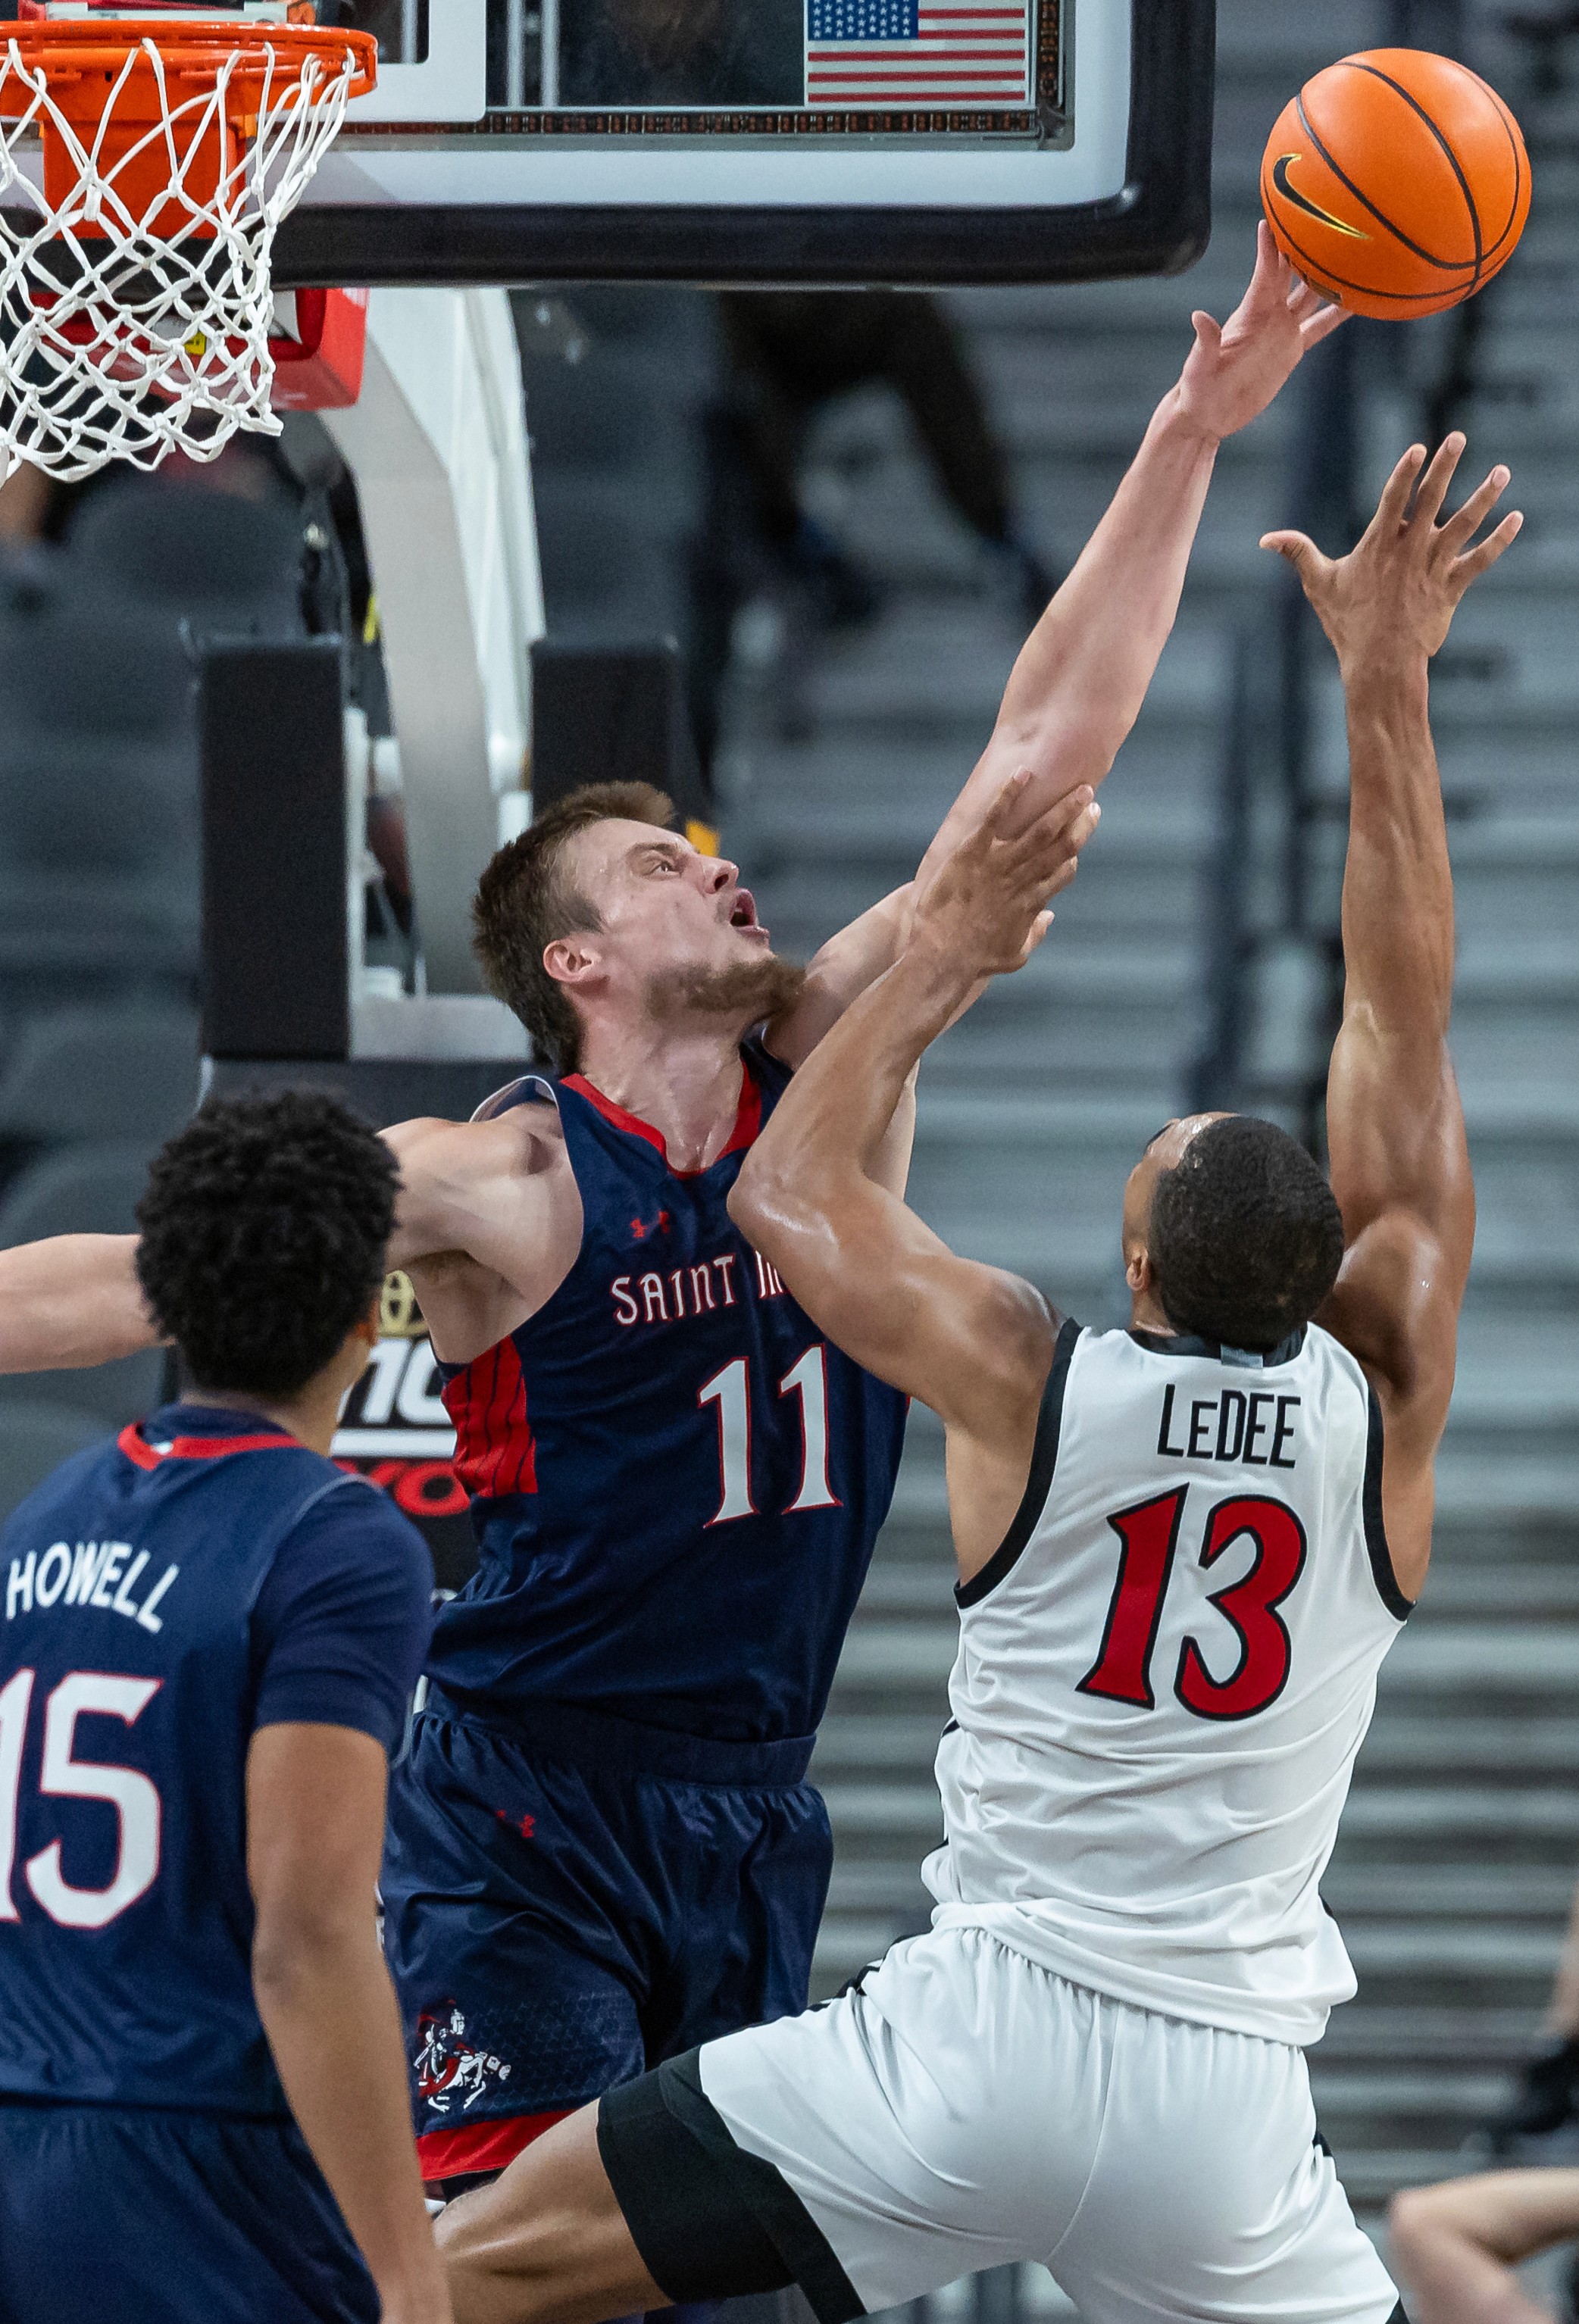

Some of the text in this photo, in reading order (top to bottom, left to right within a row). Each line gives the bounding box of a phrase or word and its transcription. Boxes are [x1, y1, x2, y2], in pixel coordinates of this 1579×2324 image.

[611, 1253, 736, 1326] SAINT
[699, 1342, 844, 1529] 11
[5, 1539, 180, 1634] HOWELL
[1075, 1482, 1308, 1722] 13
